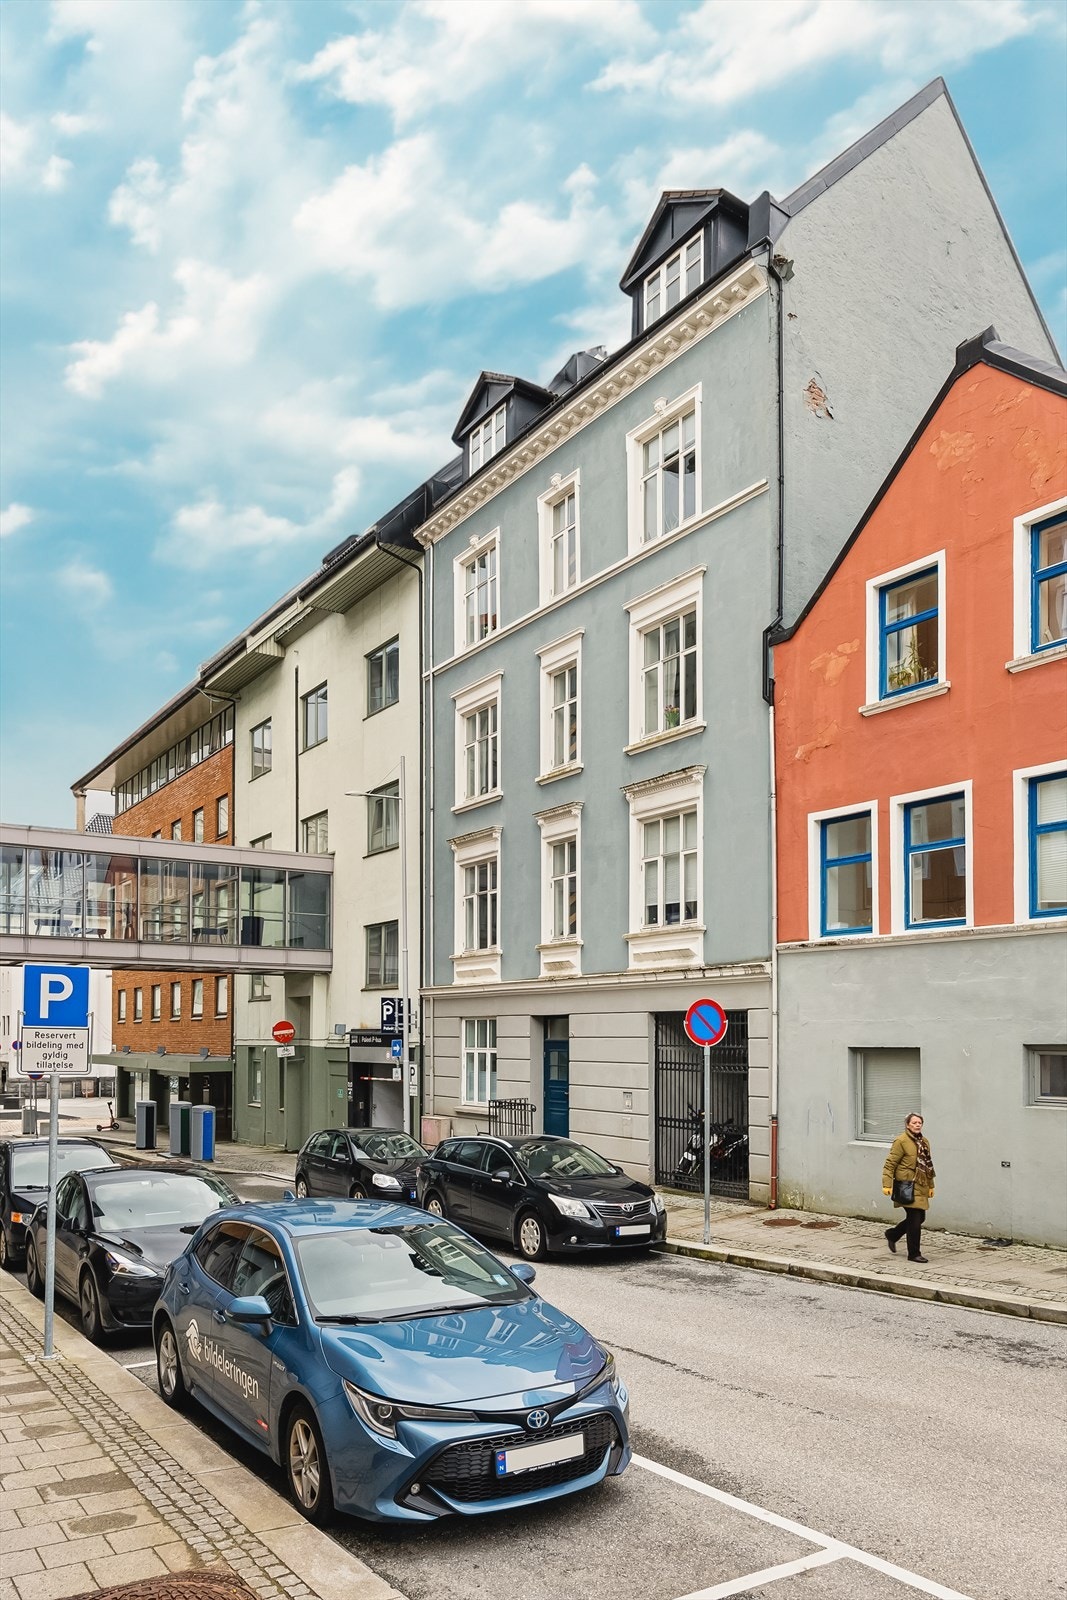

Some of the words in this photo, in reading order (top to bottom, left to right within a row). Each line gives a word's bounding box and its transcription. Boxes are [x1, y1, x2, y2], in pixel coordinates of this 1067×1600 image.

[39, 973, 74, 1019] P
[383, 1005, 394, 1021] P
[34, 1031, 76, 1039] Reservert
[26, 1041, 62, 1050] bildeling
[66, 1041, 84, 1049] med
[42, 1051, 68, 1060] gyldig
[36, 1061, 73, 1069] tillatelse
[204, 1336, 259, 1399] bildeleringen
